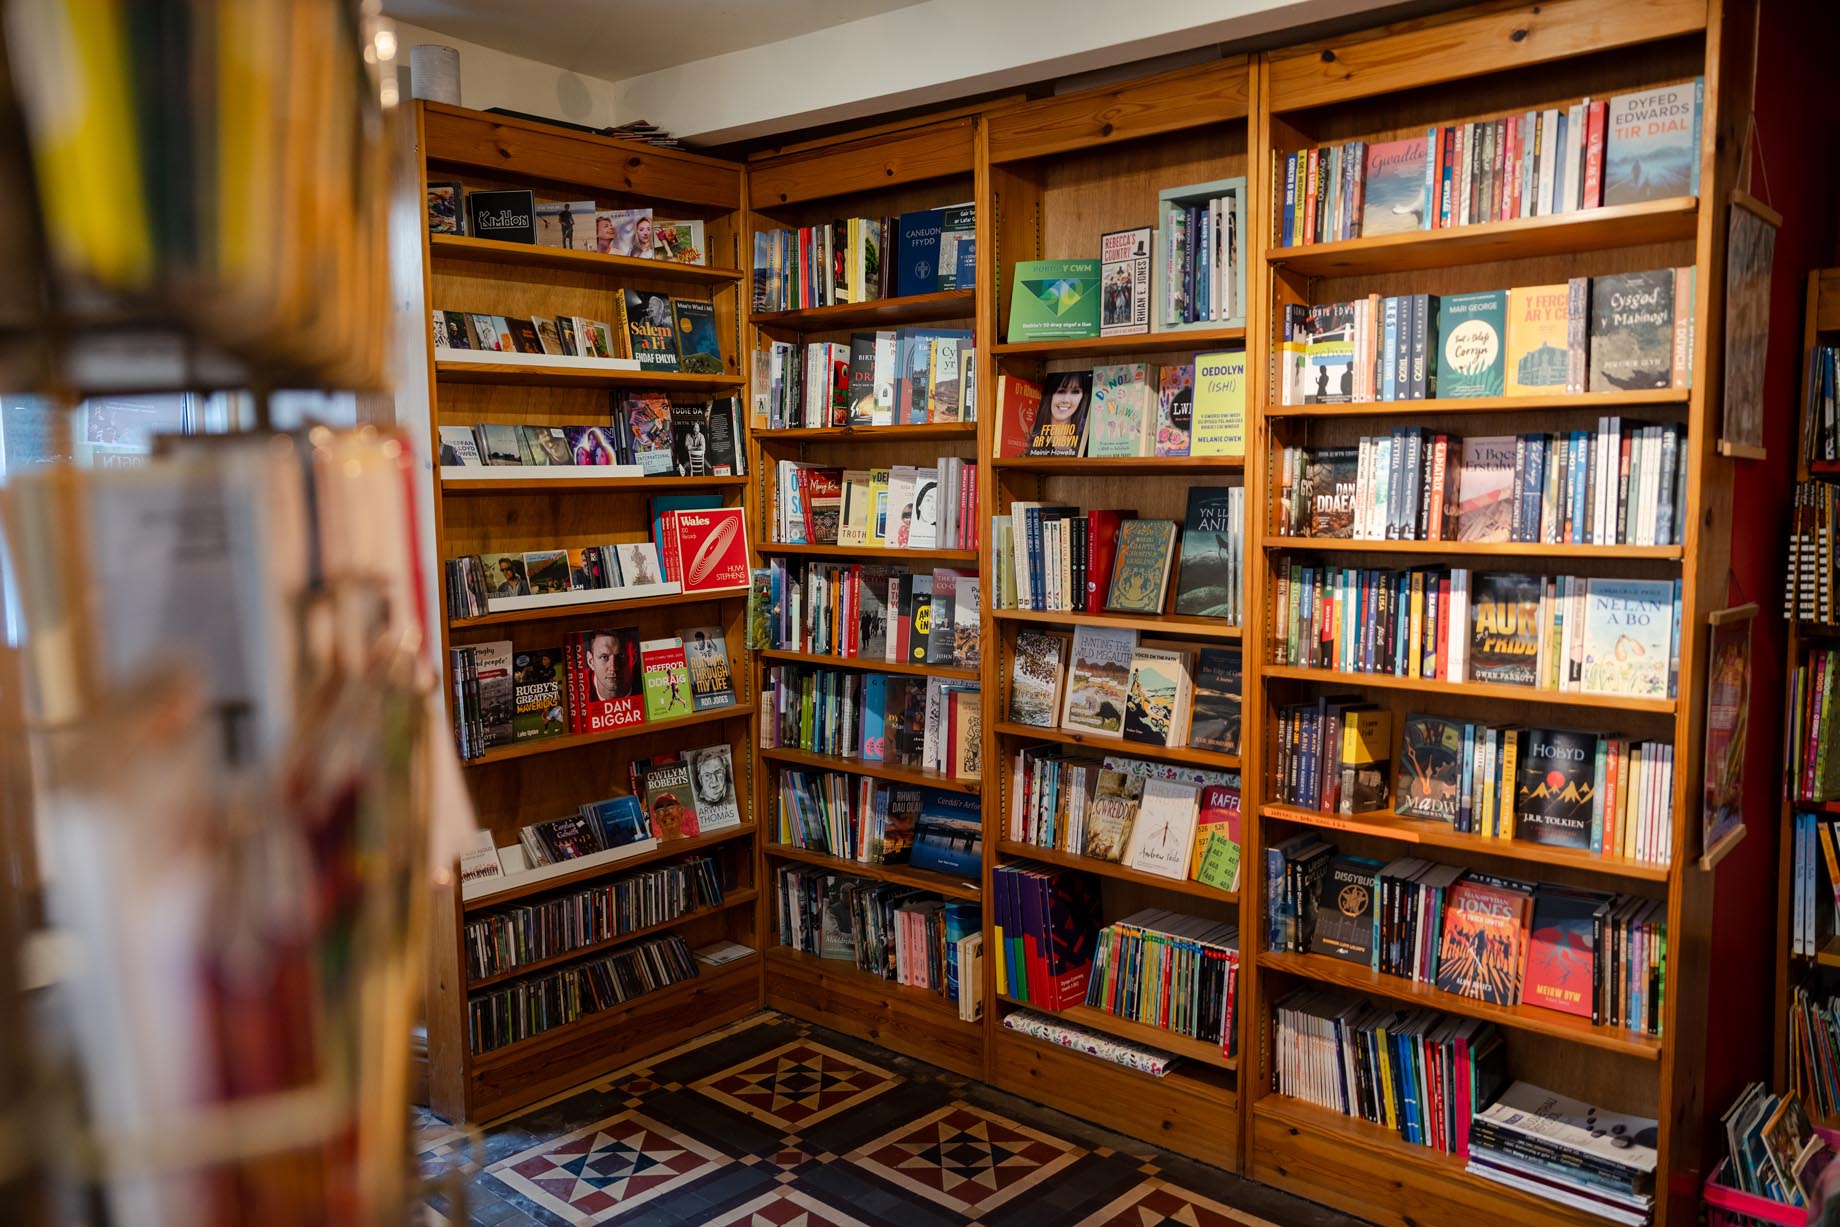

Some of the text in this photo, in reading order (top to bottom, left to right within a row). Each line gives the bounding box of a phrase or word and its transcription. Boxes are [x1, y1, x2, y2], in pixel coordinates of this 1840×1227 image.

[1628, 93, 1677, 111] DYFED
[1615, 104, 1689, 125] EDWARDS
[1615, 119, 1689, 141] TIR DIAL
[906, 227, 941, 238] CANEUON
[912, 238, 935, 247] FFYDD
[1104, 233, 1136, 248] REBECCA'S
[1104, 247, 1132, 262] COUNTRY
[1137, 260, 1147, 323] RHIAN E. JONES
[1611, 287, 1661, 311] Cysgod
[1450, 302, 1498, 313] MARI GEORGE
[1525, 310, 1541, 322] AR
[1545, 309, 1551, 321] Y
[1601, 310, 1668, 328] y Mabinogi
[630, 321, 672, 338] Salem
[642, 339, 649, 349] a
[635, 352, 676, 363] ENDAF EMLYN
[1202, 365, 1244, 377] OEDOLYN
[1208, 379, 1236, 393] (ISH!)
[1041, 424, 1075, 435] FFERMIO
[1033, 435, 1079, 447] AR Y DIBYN
[1336, 484, 1355, 496] DAN
[1200, 508, 1214, 517] YN
[680, 516, 710, 526] Wales
[716, 572, 745, 581] STEPHENS
[1597, 599, 1661, 612] NELAN
[1607, 614, 1650, 626] A BO
[646, 661, 684, 673] DEFFRO'R
[691, 654, 725, 668] RUNNING
[691, 666, 728, 680] THROUGH
[648, 674, 686, 688] DDRAIG
[697, 678, 727, 693] MY LIFE
[516, 681, 558, 697] RUGBY'S
[567, 674, 577, 718] BIGGAR
[578, 672, 587, 718] BIGGAR
[516, 691, 559, 705] GREATEST
[701, 695, 728, 706] RON JONES
[516, 700, 558, 713] MAVERICKS
[604, 700, 631, 714] DAN
[592, 712, 642, 729] BIGGAR
[1533, 744, 1584, 761] HOBYD
[647, 767, 687, 782] GWILYM
[648, 775, 689, 789] ROBERTS
[699, 803, 727, 815] ARWYN
[700, 810, 735, 823] THOMAS
[1544, 816, 1584, 829] TOLKIEN
[1456, 897, 1512, 920] JONES
[1537, 984, 1562, 998] MEIRW
[1564, 990, 1581, 1002] BYW
